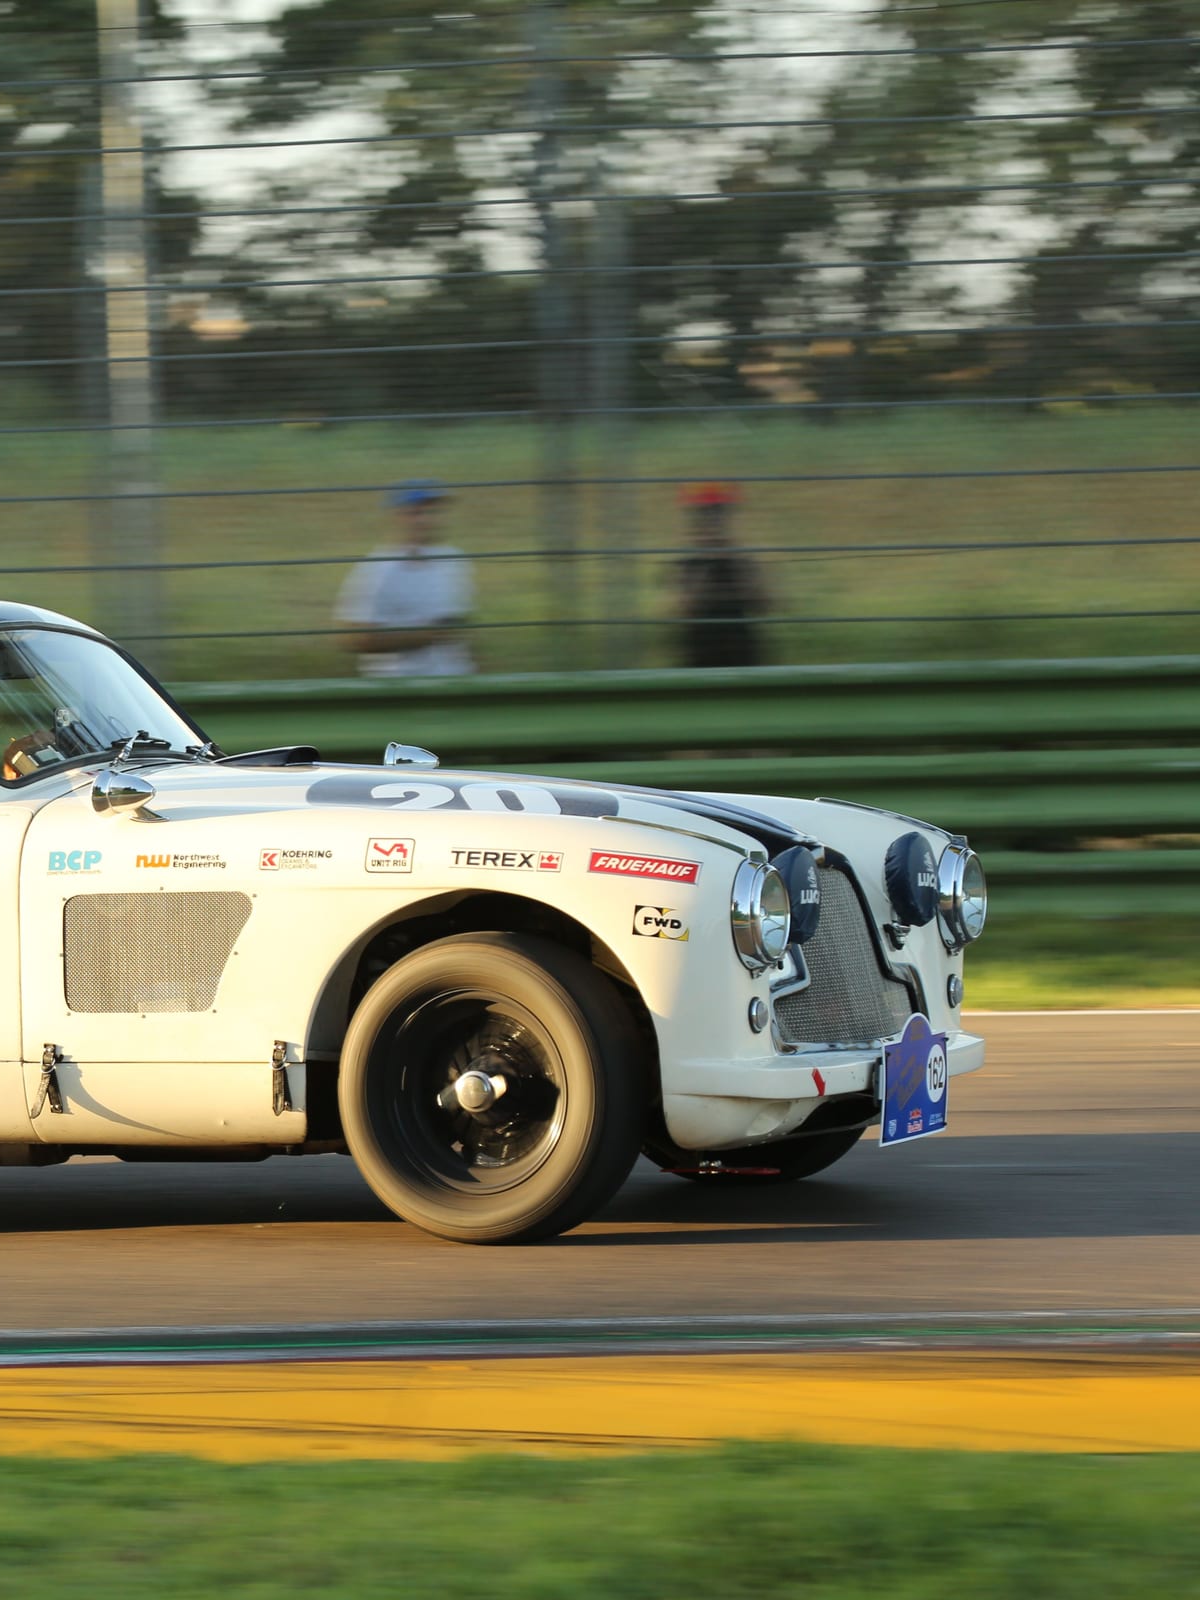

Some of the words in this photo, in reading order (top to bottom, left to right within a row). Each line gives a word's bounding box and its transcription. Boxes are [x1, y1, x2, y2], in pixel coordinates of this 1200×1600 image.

[48, 850, 102, 871] BCP
[282, 850, 333, 858] KOEHRING
[451, 850, 535, 868] TEREX
[173, 861, 227, 869] Engineering
[371, 859, 391, 867] UNIT
[393, 859, 407, 867] RIG
[594, 856, 693, 878] FRUEHAUF
[643, 916, 682, 930] FWD
[928, 1055, 944, 1091] 162
